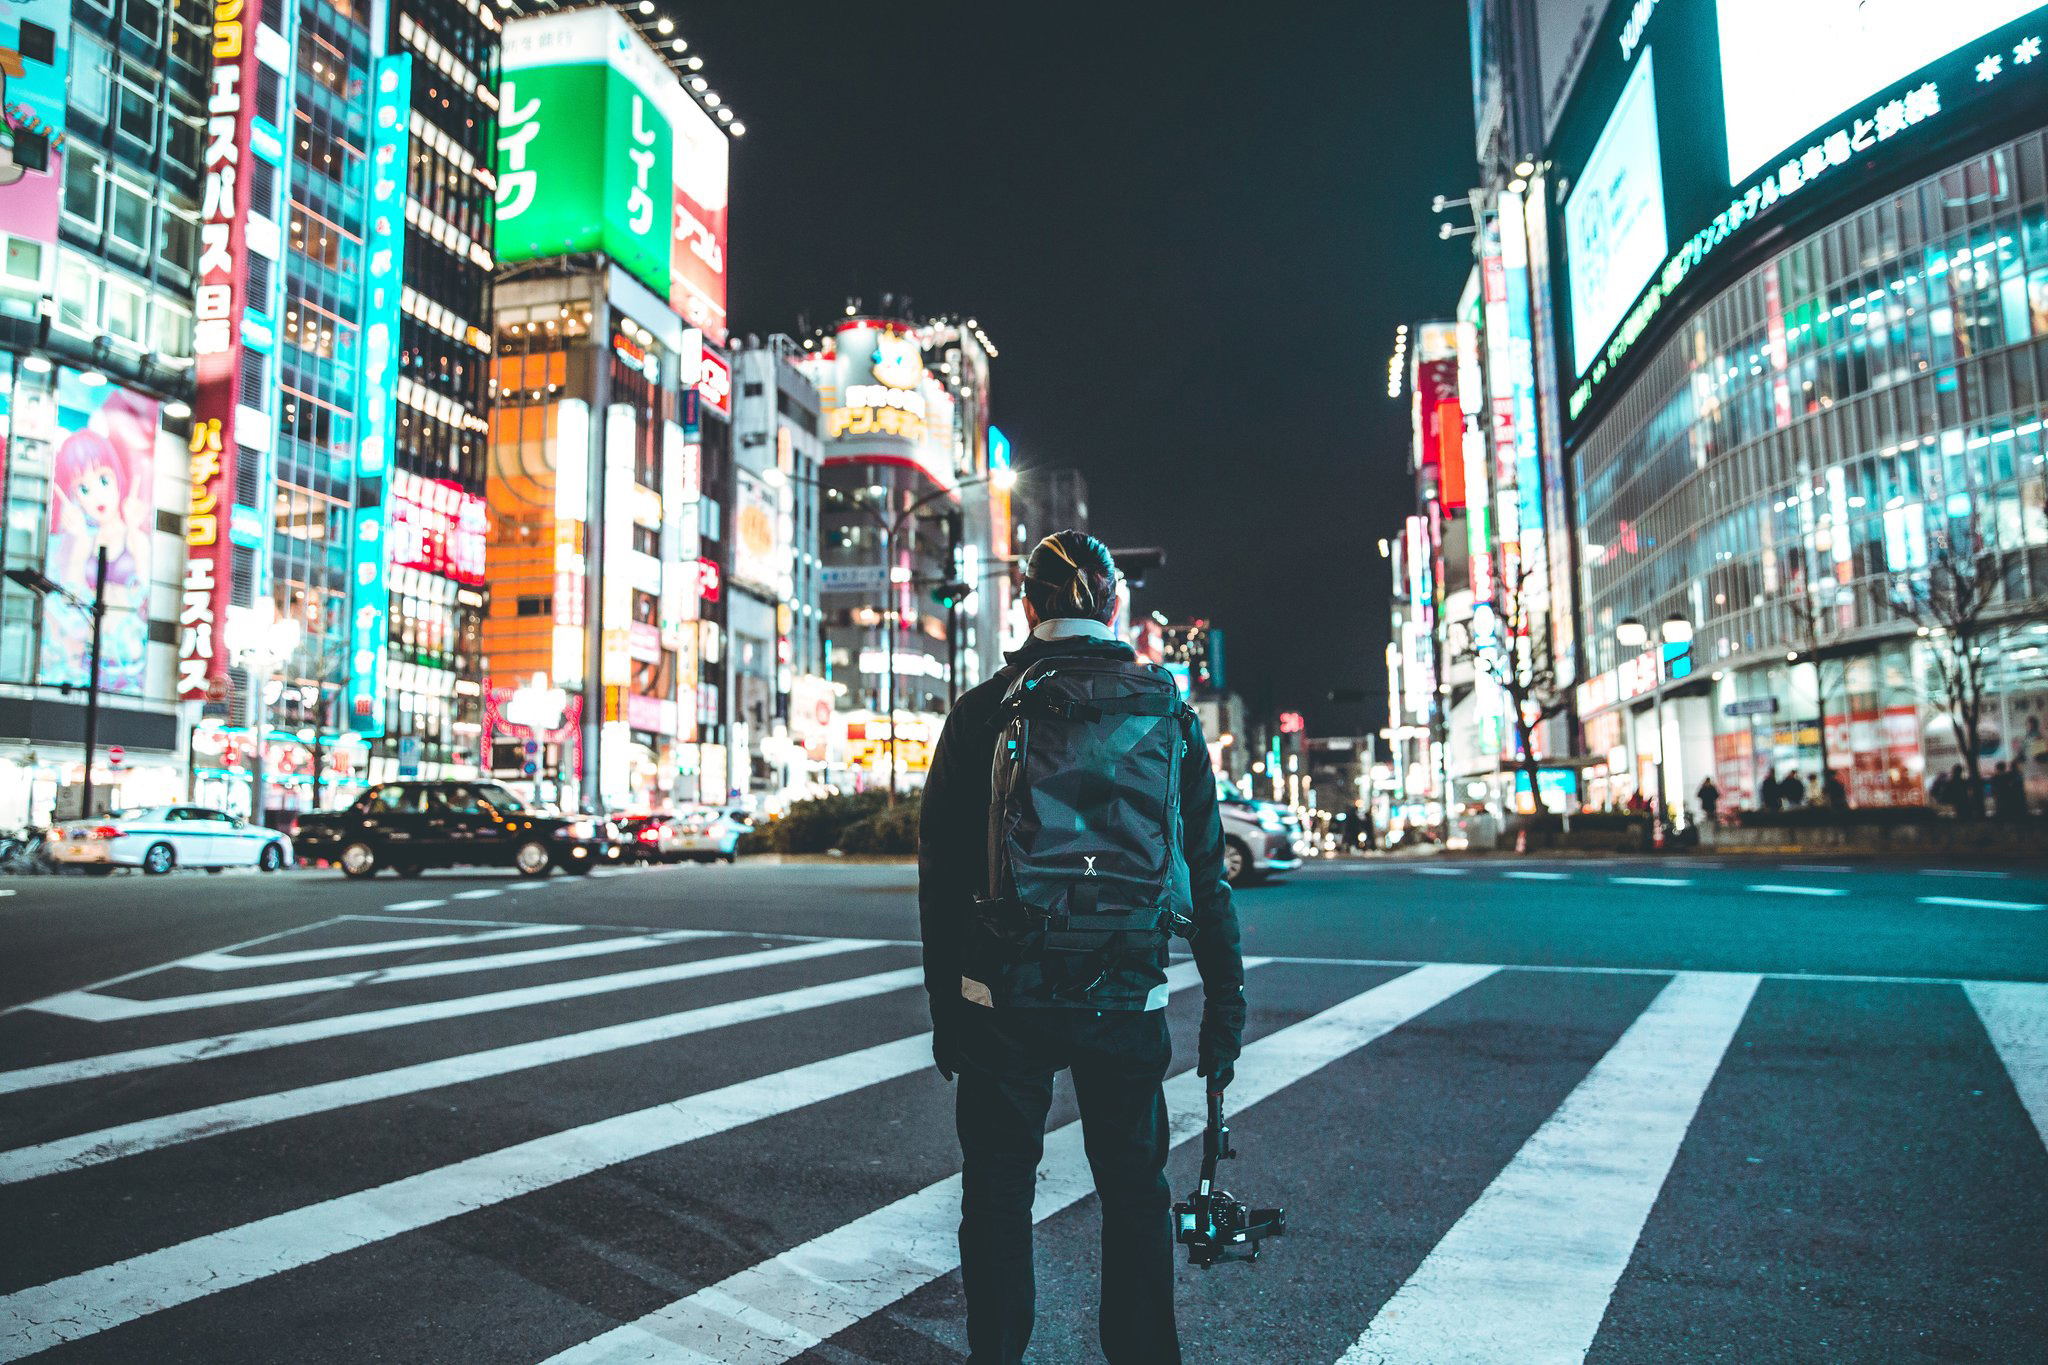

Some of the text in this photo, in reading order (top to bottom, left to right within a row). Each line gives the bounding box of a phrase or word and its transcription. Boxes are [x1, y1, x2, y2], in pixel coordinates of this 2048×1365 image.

[495, 81, 541, 221] レイク
[627, 94, 655, 235] レイク
[177, 418, 222, 694] パチンコ エスパス
